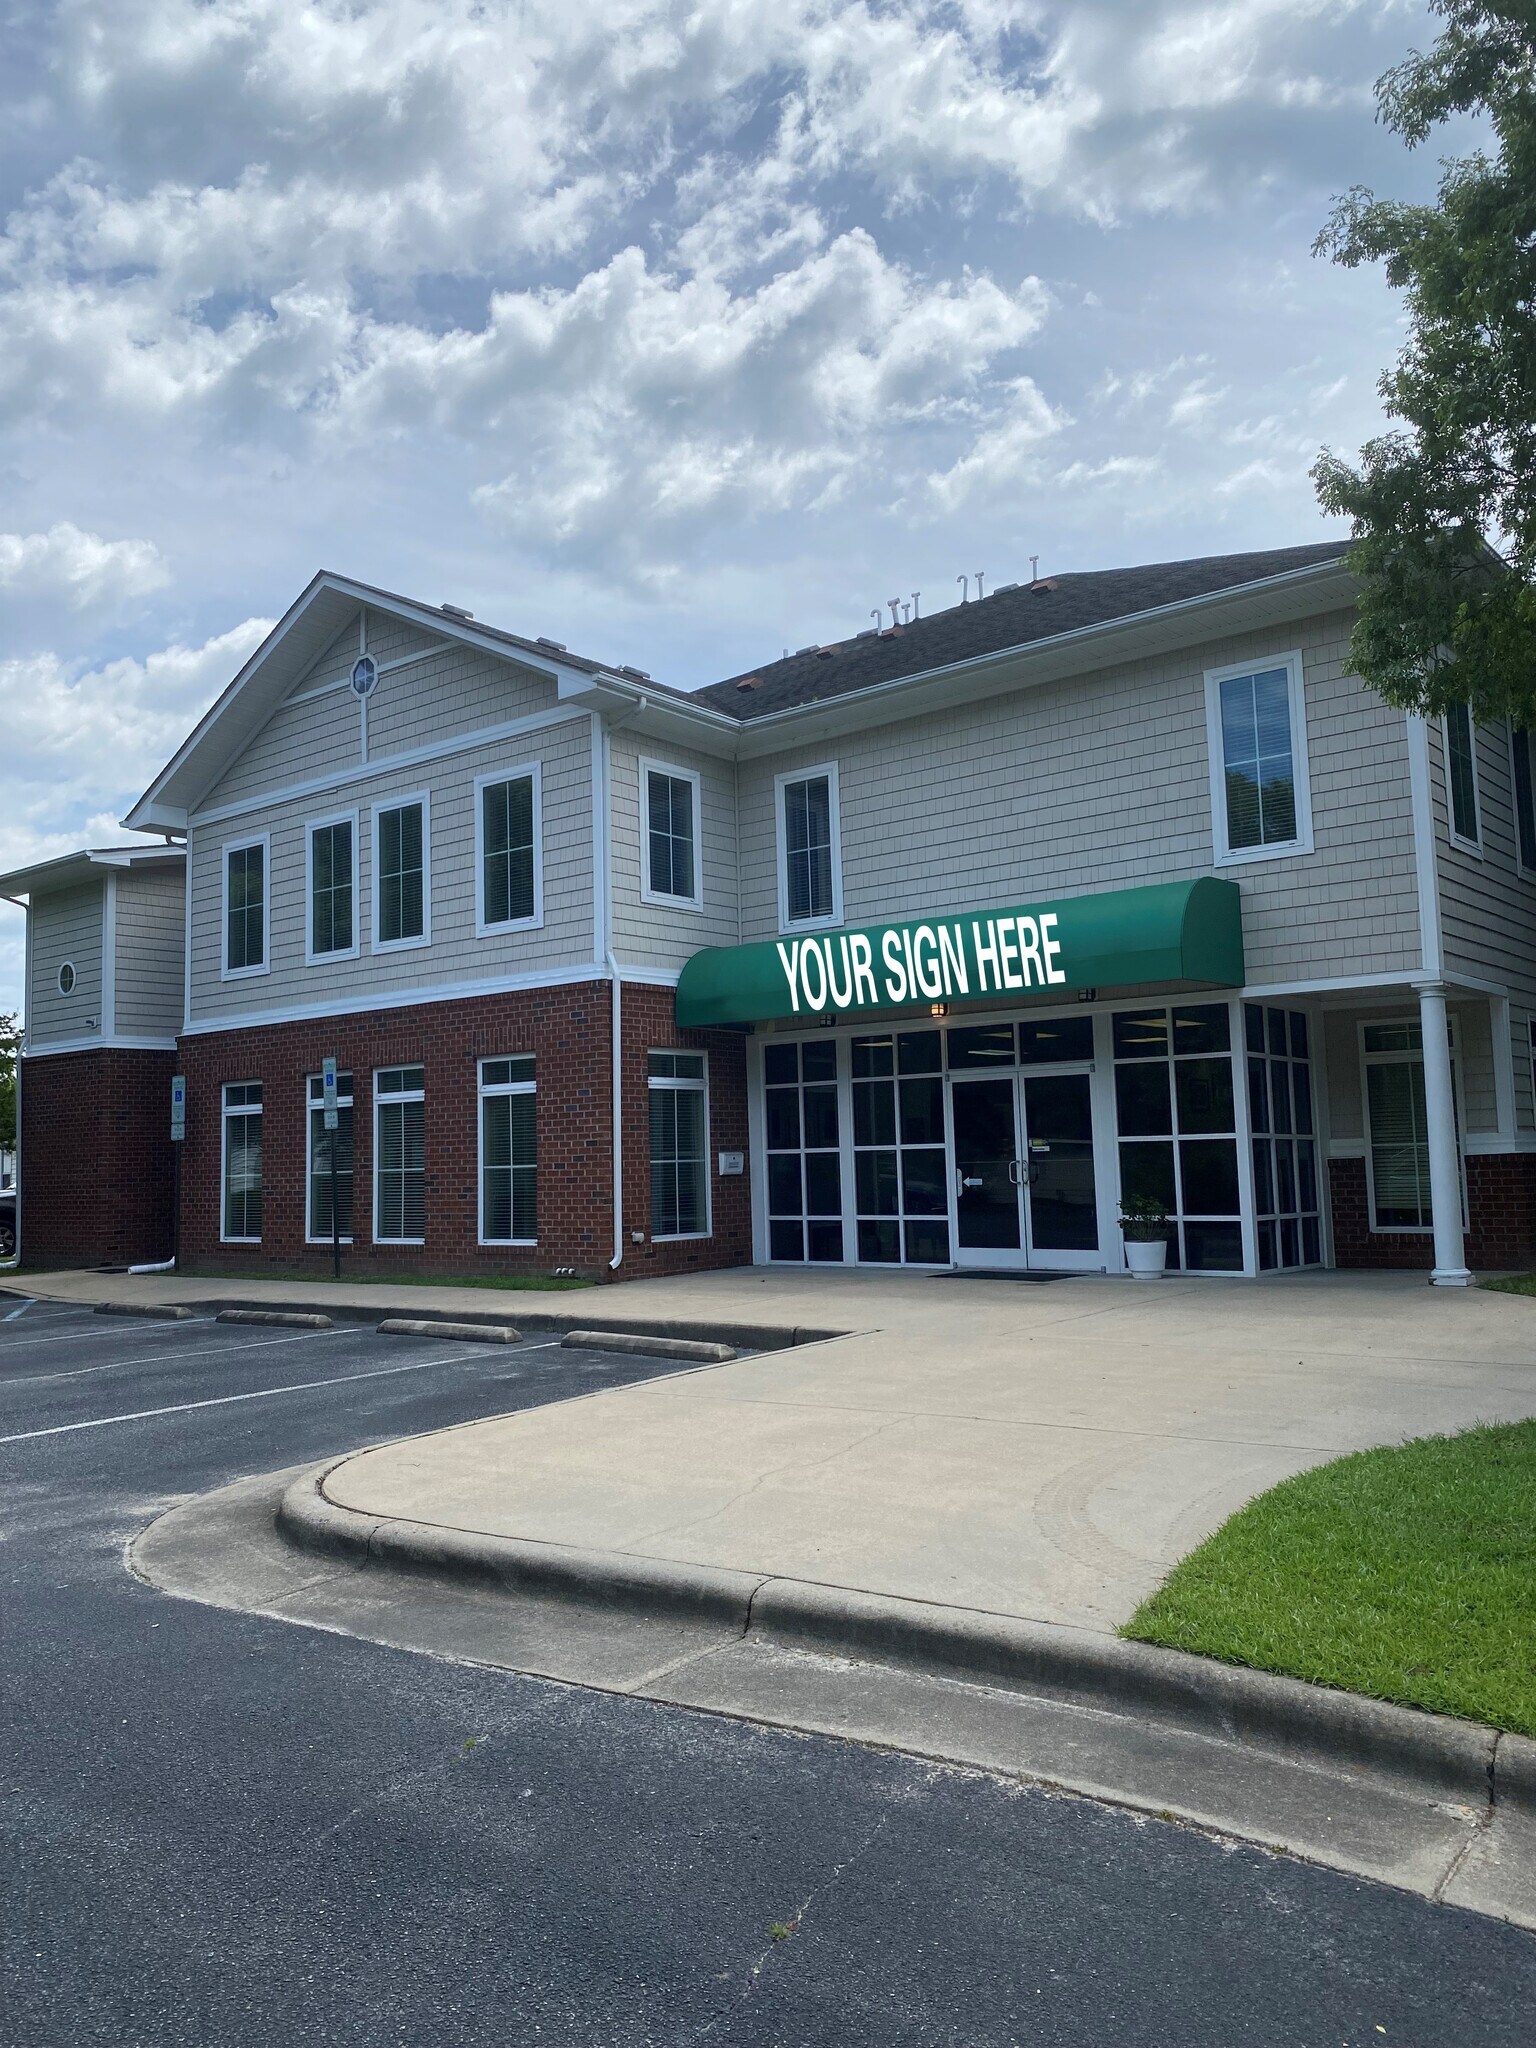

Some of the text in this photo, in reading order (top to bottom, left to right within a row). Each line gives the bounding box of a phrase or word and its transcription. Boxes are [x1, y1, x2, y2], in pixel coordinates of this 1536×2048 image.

[776, 913, 1066, 1012] YOUR SIGN HERE
